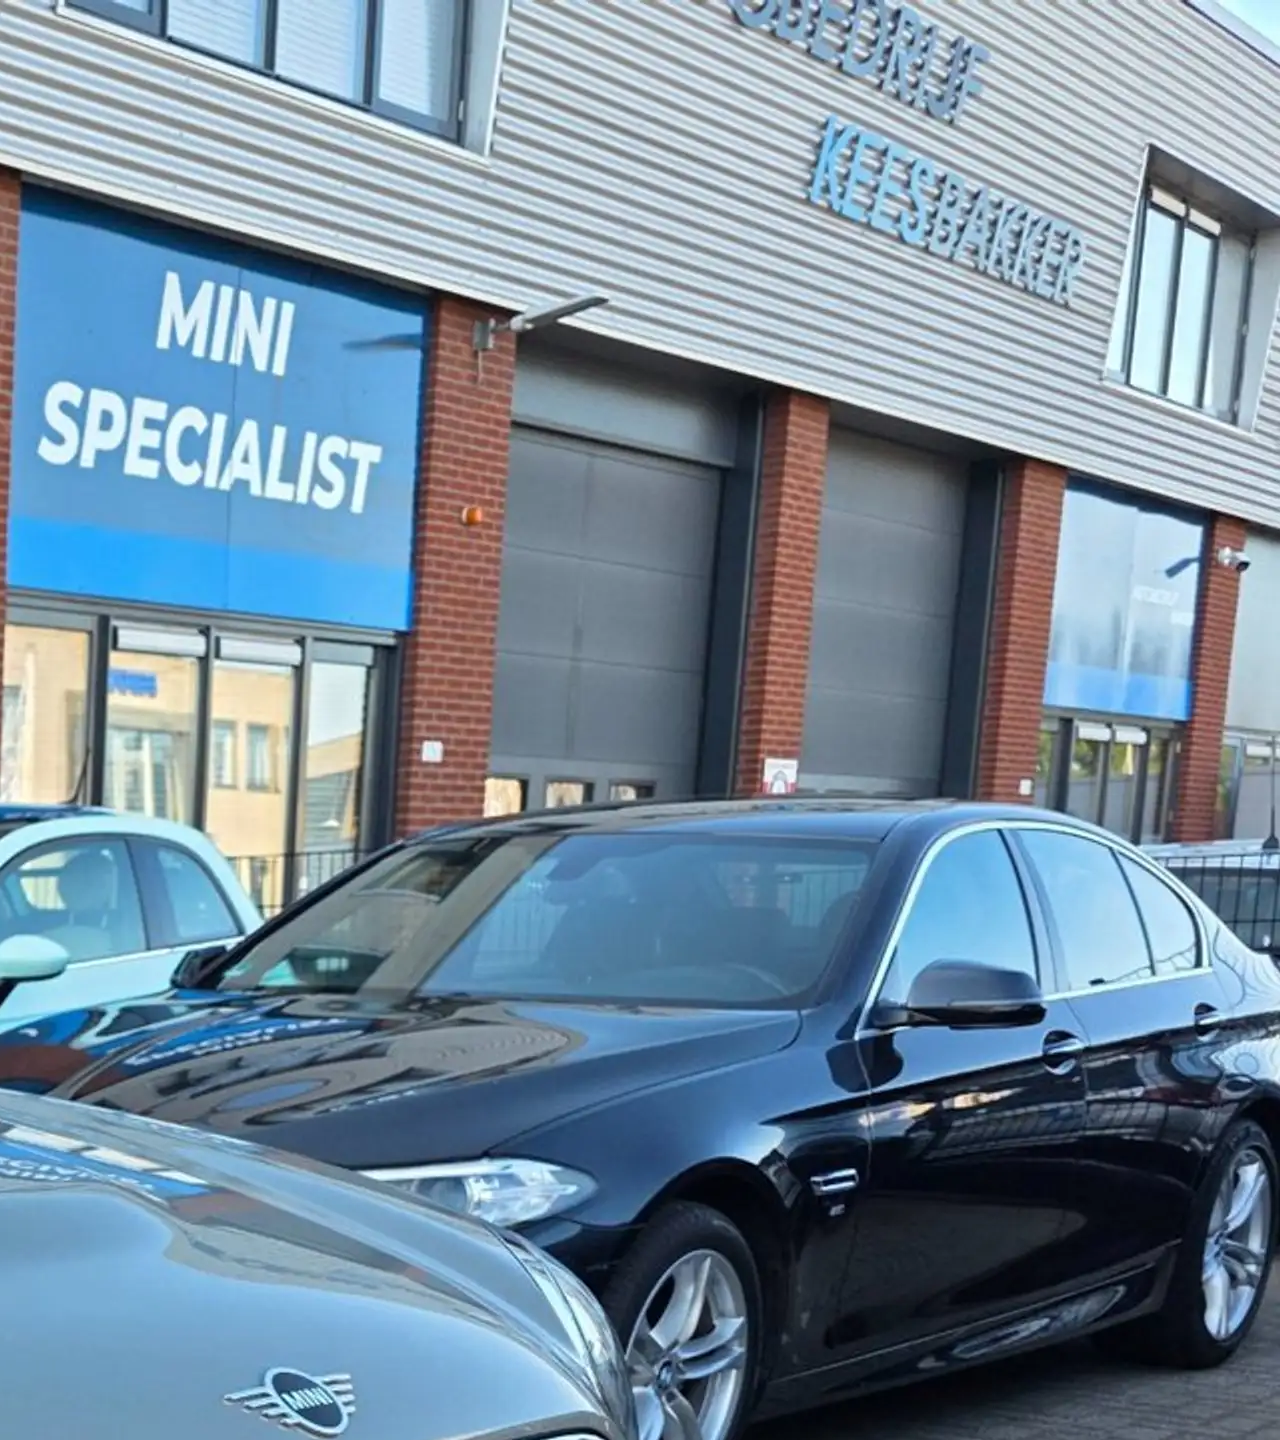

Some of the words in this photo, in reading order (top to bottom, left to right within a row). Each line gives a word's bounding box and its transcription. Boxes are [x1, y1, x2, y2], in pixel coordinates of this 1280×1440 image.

[155, 271, 295, 376] MINI
[37, 381, 382, 514] SPECIALIST
[281, 1387, 334, 1410] MINI
